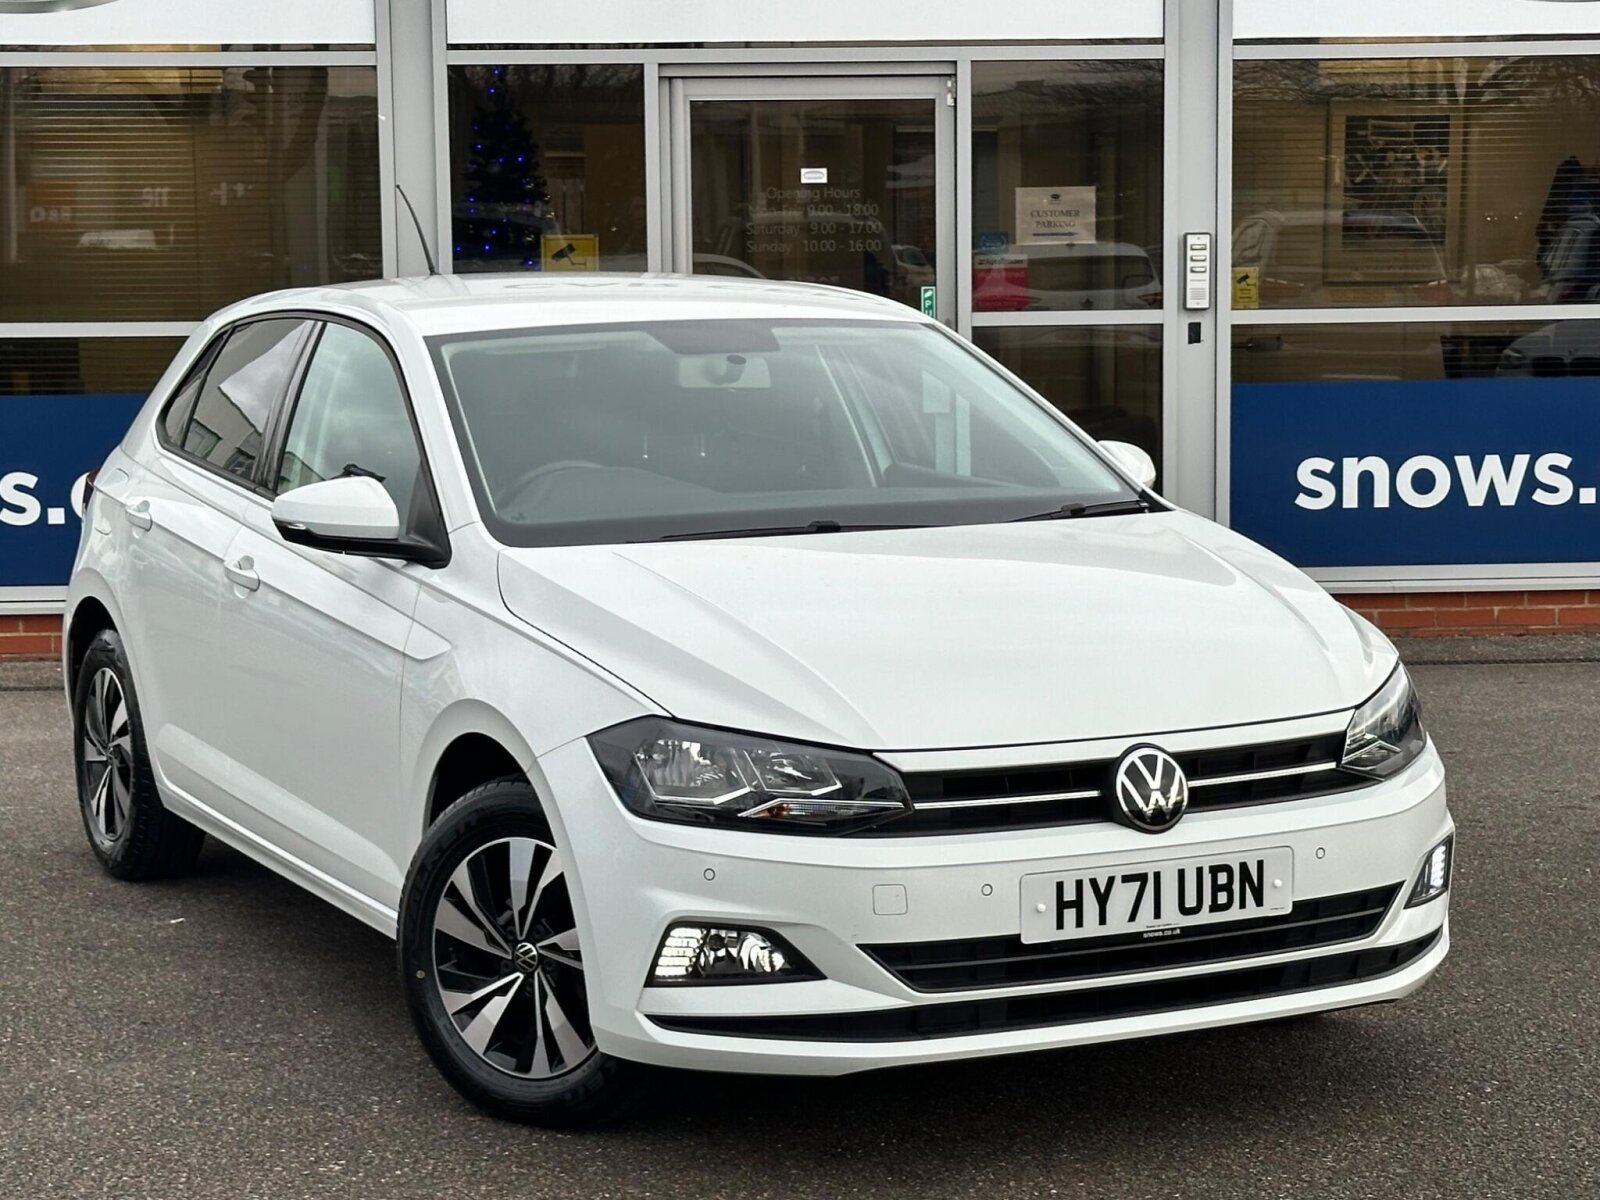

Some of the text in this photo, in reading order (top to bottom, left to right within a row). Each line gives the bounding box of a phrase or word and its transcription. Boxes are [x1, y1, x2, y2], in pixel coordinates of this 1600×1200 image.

[767, 187, 861, 202] Opening Hours
[1030, 209, 1080, 218] CUSTOMER
[745, 221, 800, 237] Saturday
[810, 221, 836, 234] 9.00
[849, 221, 882, 234] 17.00
[1035, 220, 1077, 229] PARKING
[746, 240, 793, 256] Sunday
[803, 239, 836, 252] 10.00
[848, 239, 882, 252] 16.00
[1056, 860, 1264, 930] HY71 UBN
